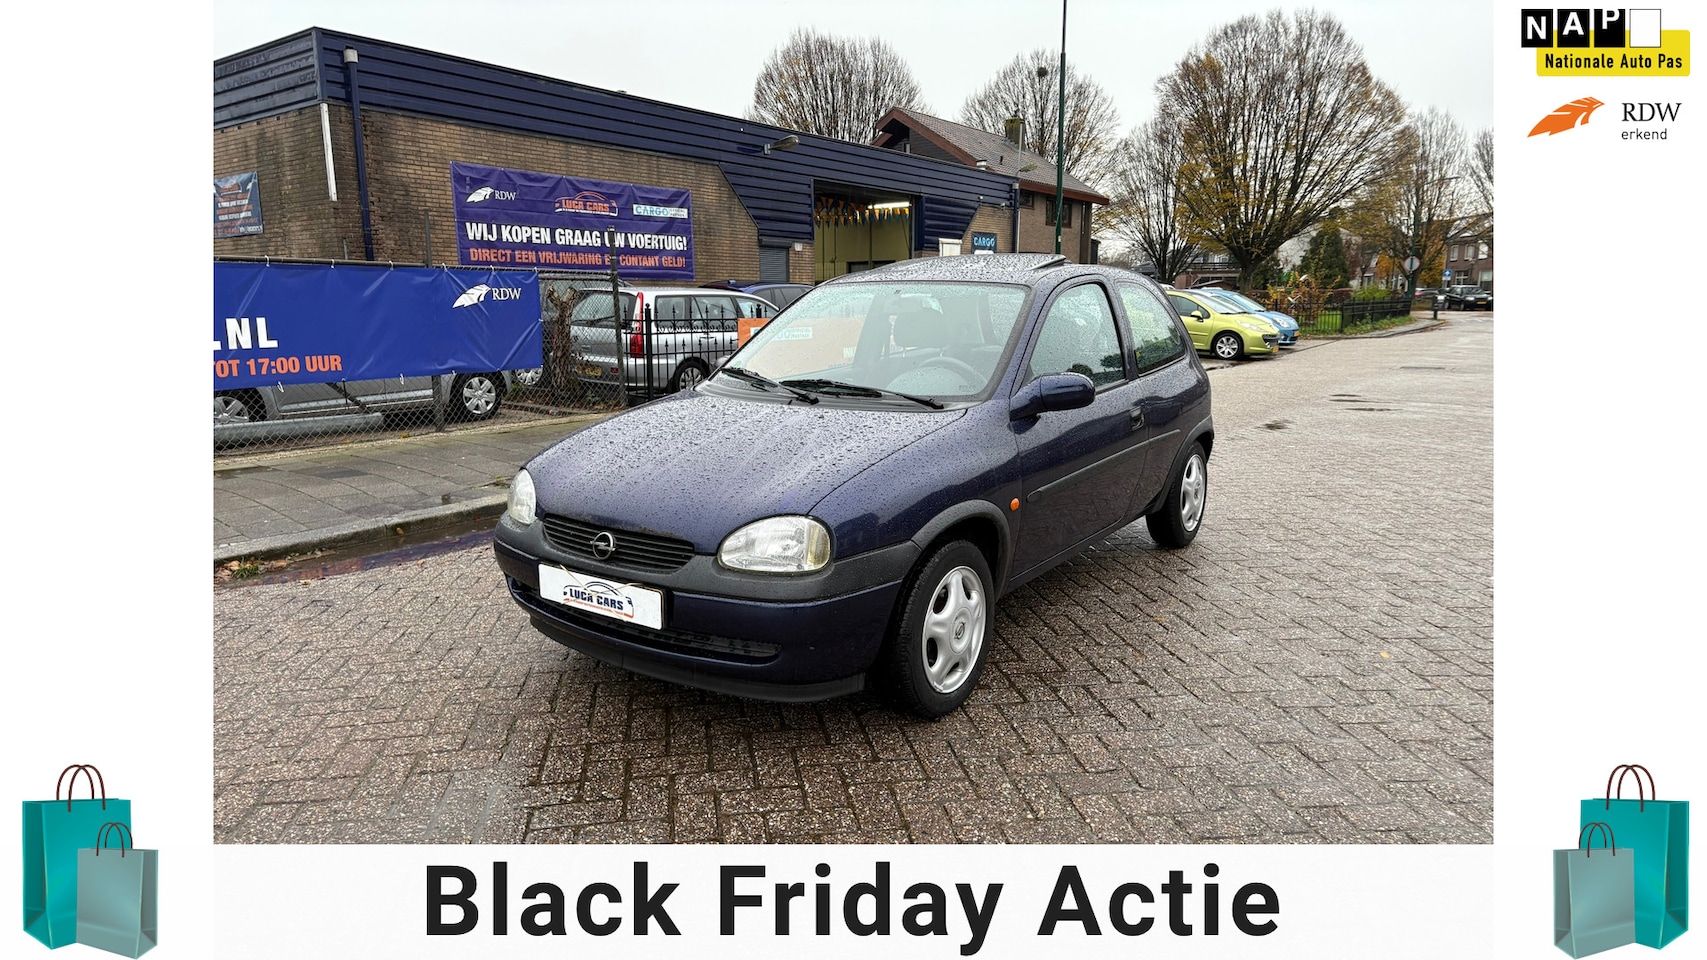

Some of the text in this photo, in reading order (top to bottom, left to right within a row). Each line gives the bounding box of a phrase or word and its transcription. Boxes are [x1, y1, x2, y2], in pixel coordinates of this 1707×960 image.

[495, 190, 516, 200] RDW
[562, 200, 610, 212] LUCA CARS
[635, 205, 669, 216] CARGO
[465, 222, 498, 241] WIJ
[501, 225, 551, 245] KOPEN
[555, 228, 601, 247] GRAAG
[628, 233, 687, 250] VOERTUIG!
[973, 237, 995, 247] CARGO
[470, 248, 512, 264] DIRECT
[515, 250, 537, 263] EEN
[538, 251, 602, 265] VRIJWARING
[619, 254, 659, 267] CONTANT
[662, 256, 686, 267] GELD!
[492, 287, 522, 301] RDW
[213, 355, 343, 378] OT 17:00 UUR
[569, 588, 594, 603] LUCA
[596, 595, 624, 611] CARS
